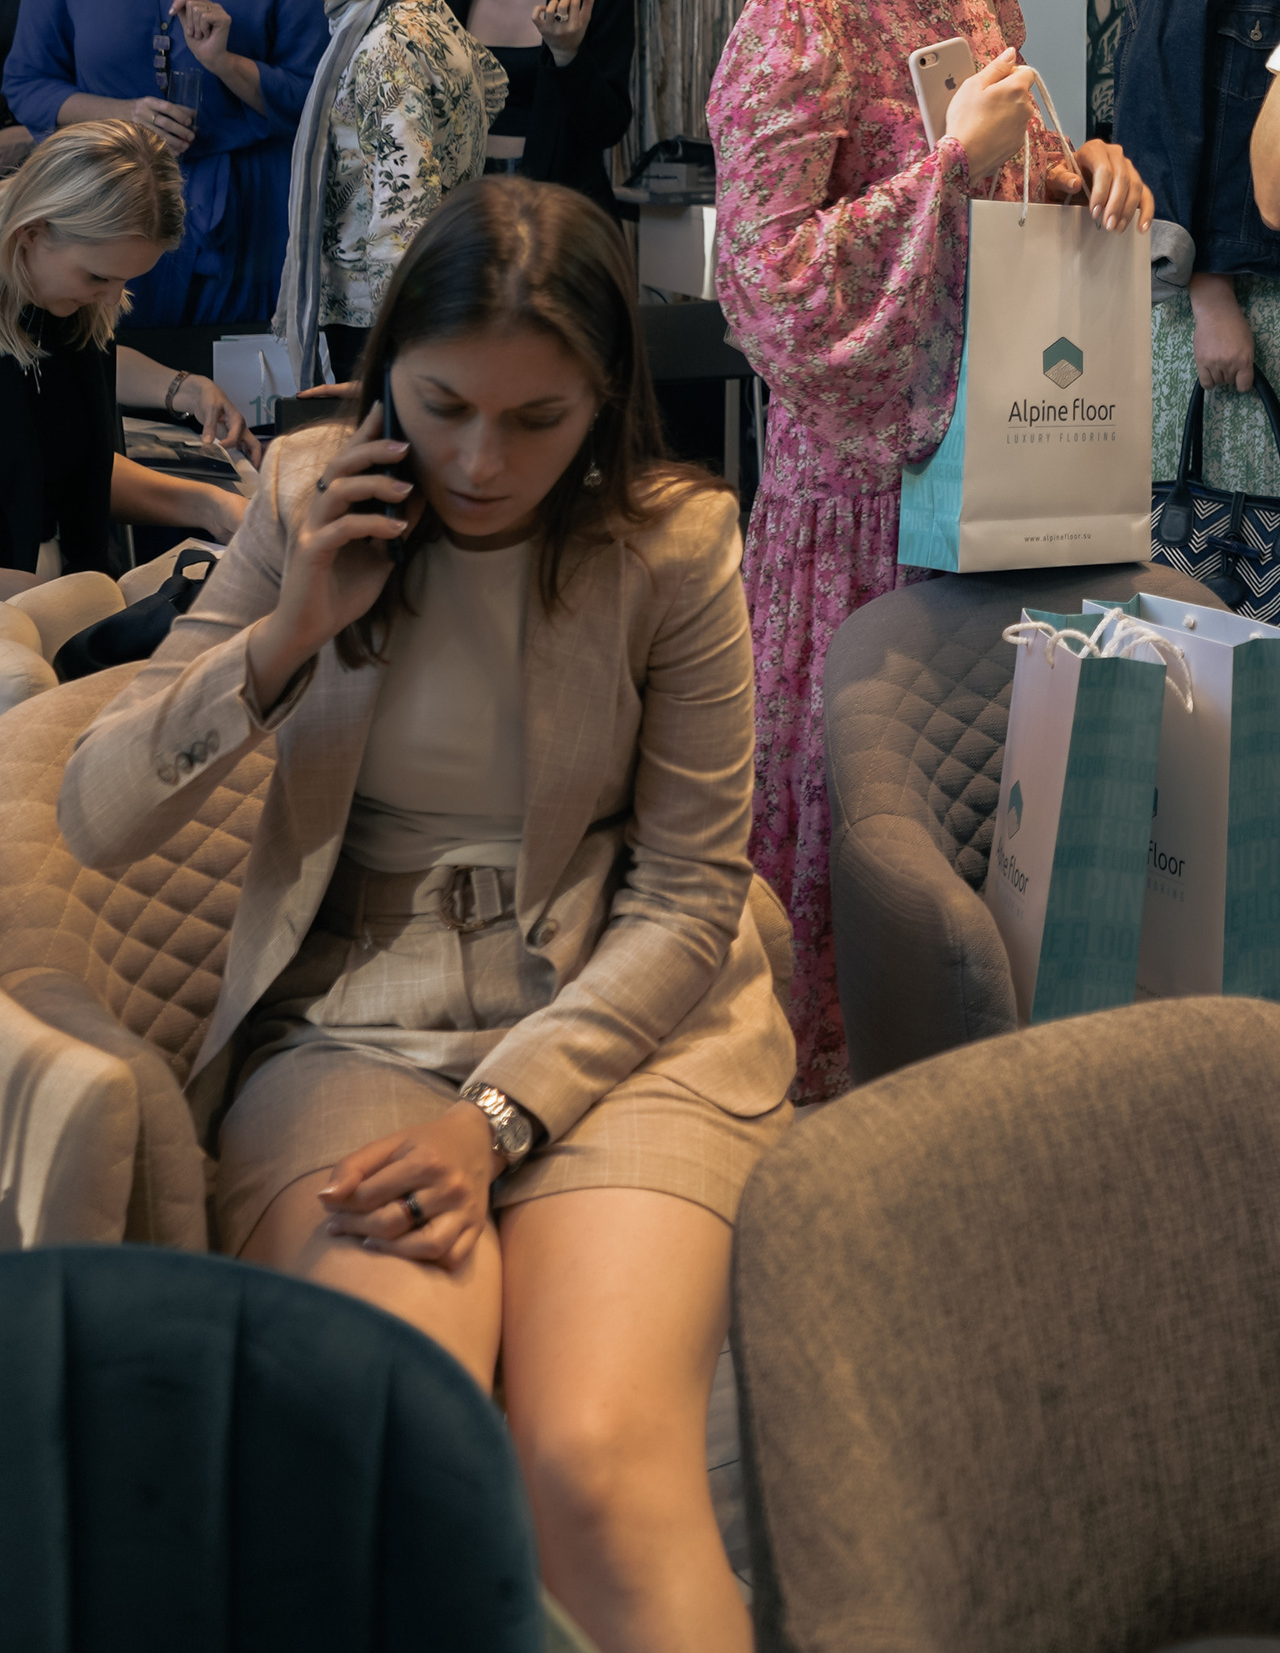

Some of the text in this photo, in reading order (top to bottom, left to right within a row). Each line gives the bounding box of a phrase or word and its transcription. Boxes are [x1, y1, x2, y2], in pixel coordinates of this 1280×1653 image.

[1008, 398, 1116, 427] Alpine floor
[1006, 431, 1116, 444] LUXURY FLOORING
